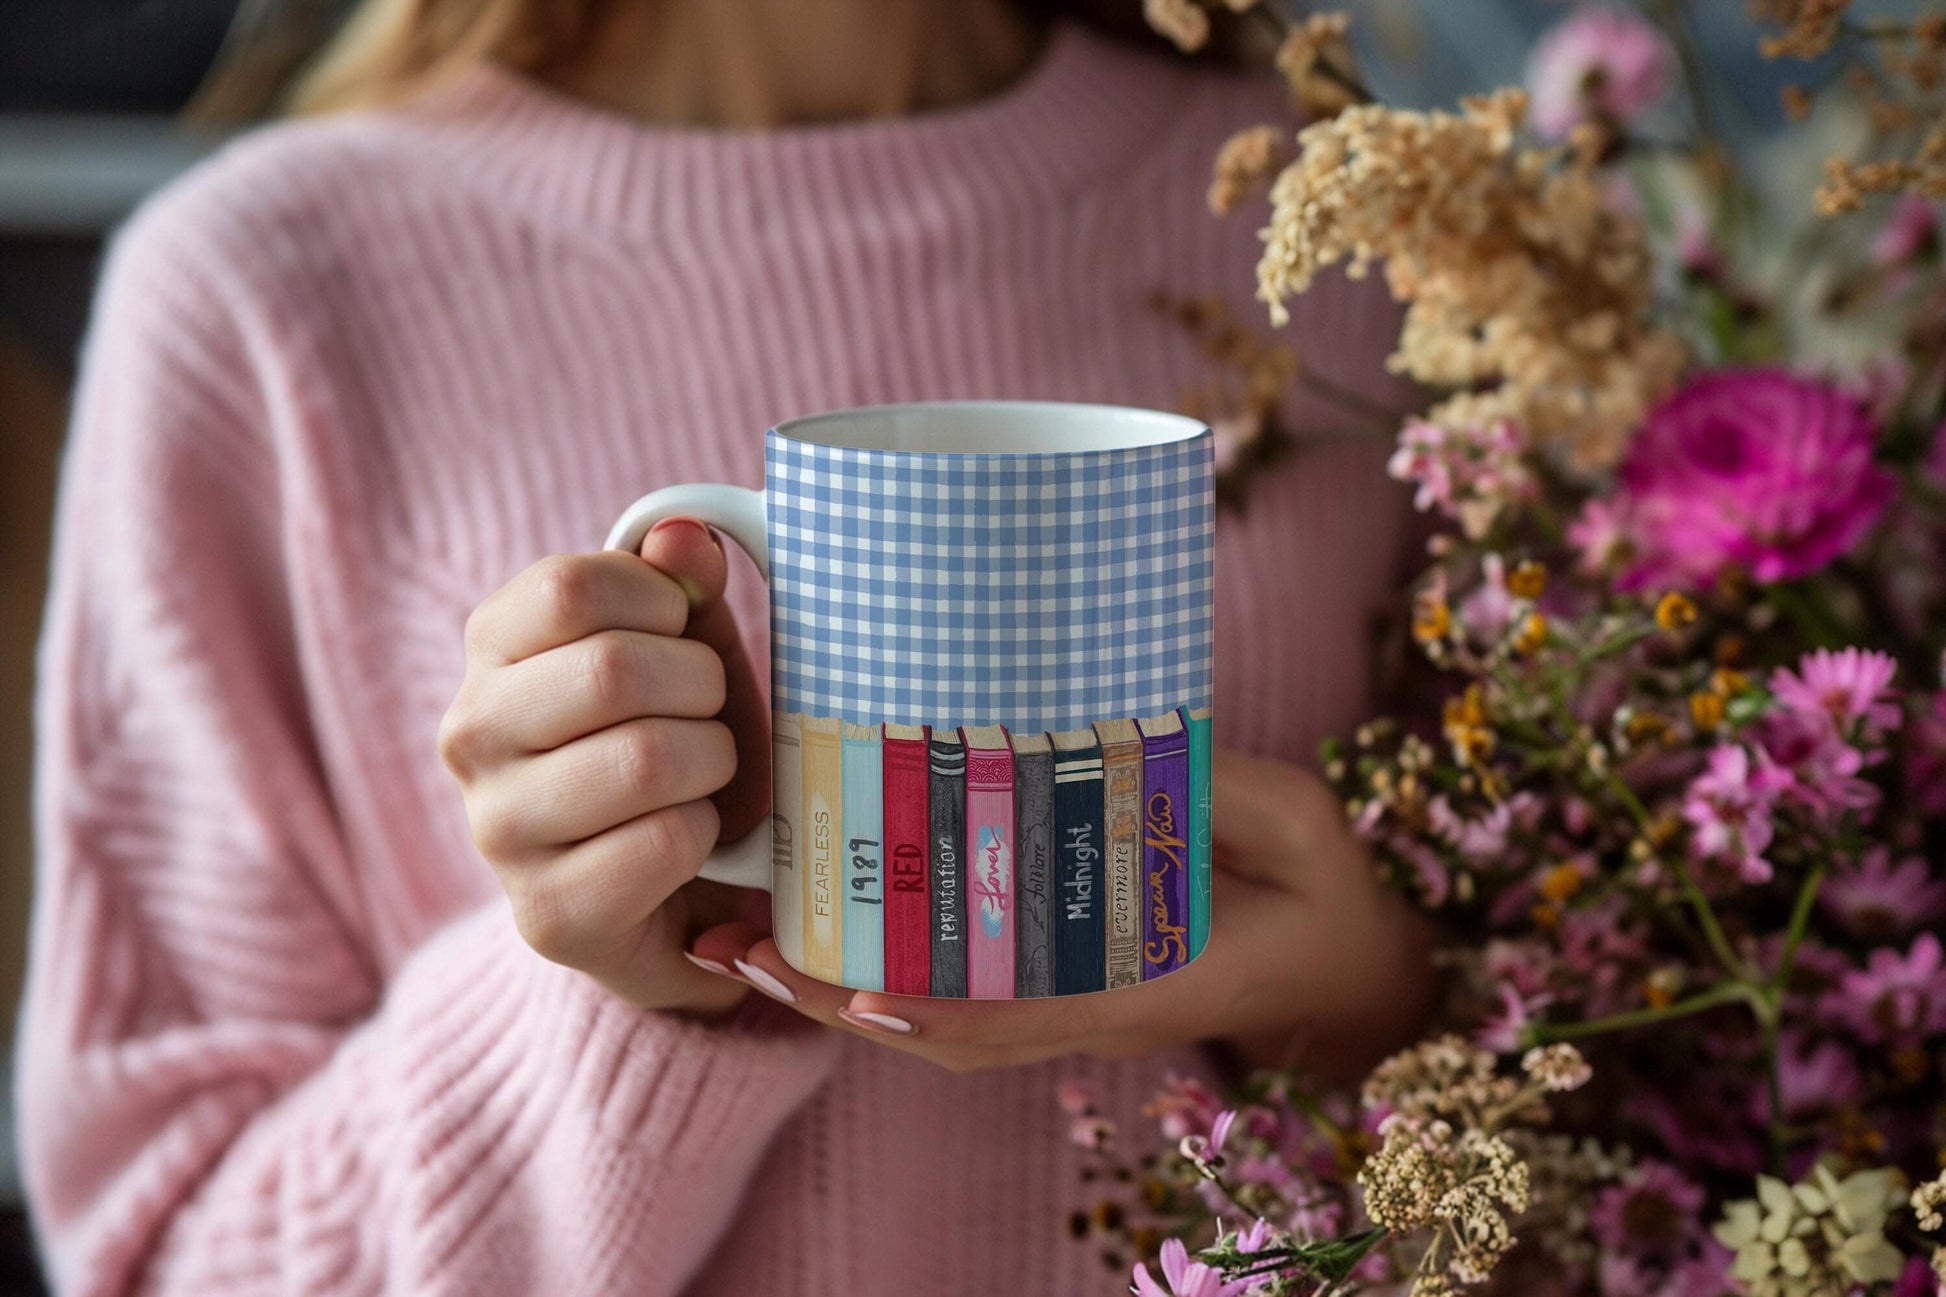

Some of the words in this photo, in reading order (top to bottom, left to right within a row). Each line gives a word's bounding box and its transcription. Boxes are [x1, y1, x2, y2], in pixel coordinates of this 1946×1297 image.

[815, 811, 829, 917] FEARLESS
[849, 838, 882, 905] 1989
[893, 843, 925, 893] RED
[939, 836, 958, 942] reputation
[973, 826, 1012, 914] Lover
[1023, 843, 1047, 904] folklore
[1064, 823, 1099, 920] Midnight
[1113, 846, 1129, 934] evermore
[1144, 862, 1187, 964] Speak
